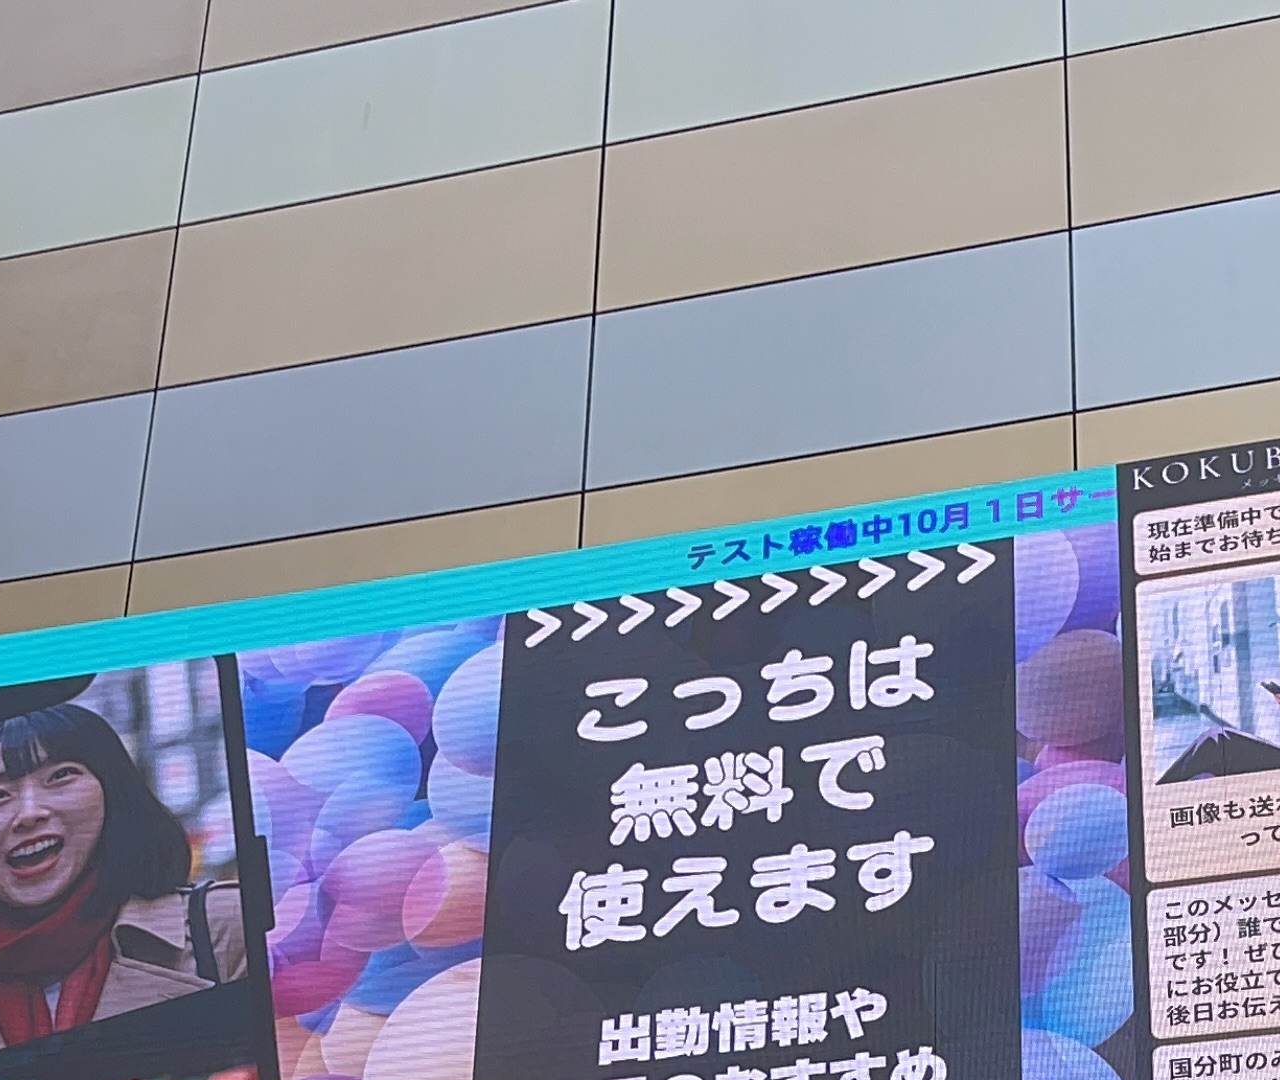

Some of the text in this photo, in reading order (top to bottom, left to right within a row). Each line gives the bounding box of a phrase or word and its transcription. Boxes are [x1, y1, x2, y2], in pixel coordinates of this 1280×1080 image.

[577, 635, 934, 742] こっちは
[609, 735, 886, 846] 無料で
[558, 830, 935, 951] 使えます
[598, 987, 888, 1065] 出勤情報や
